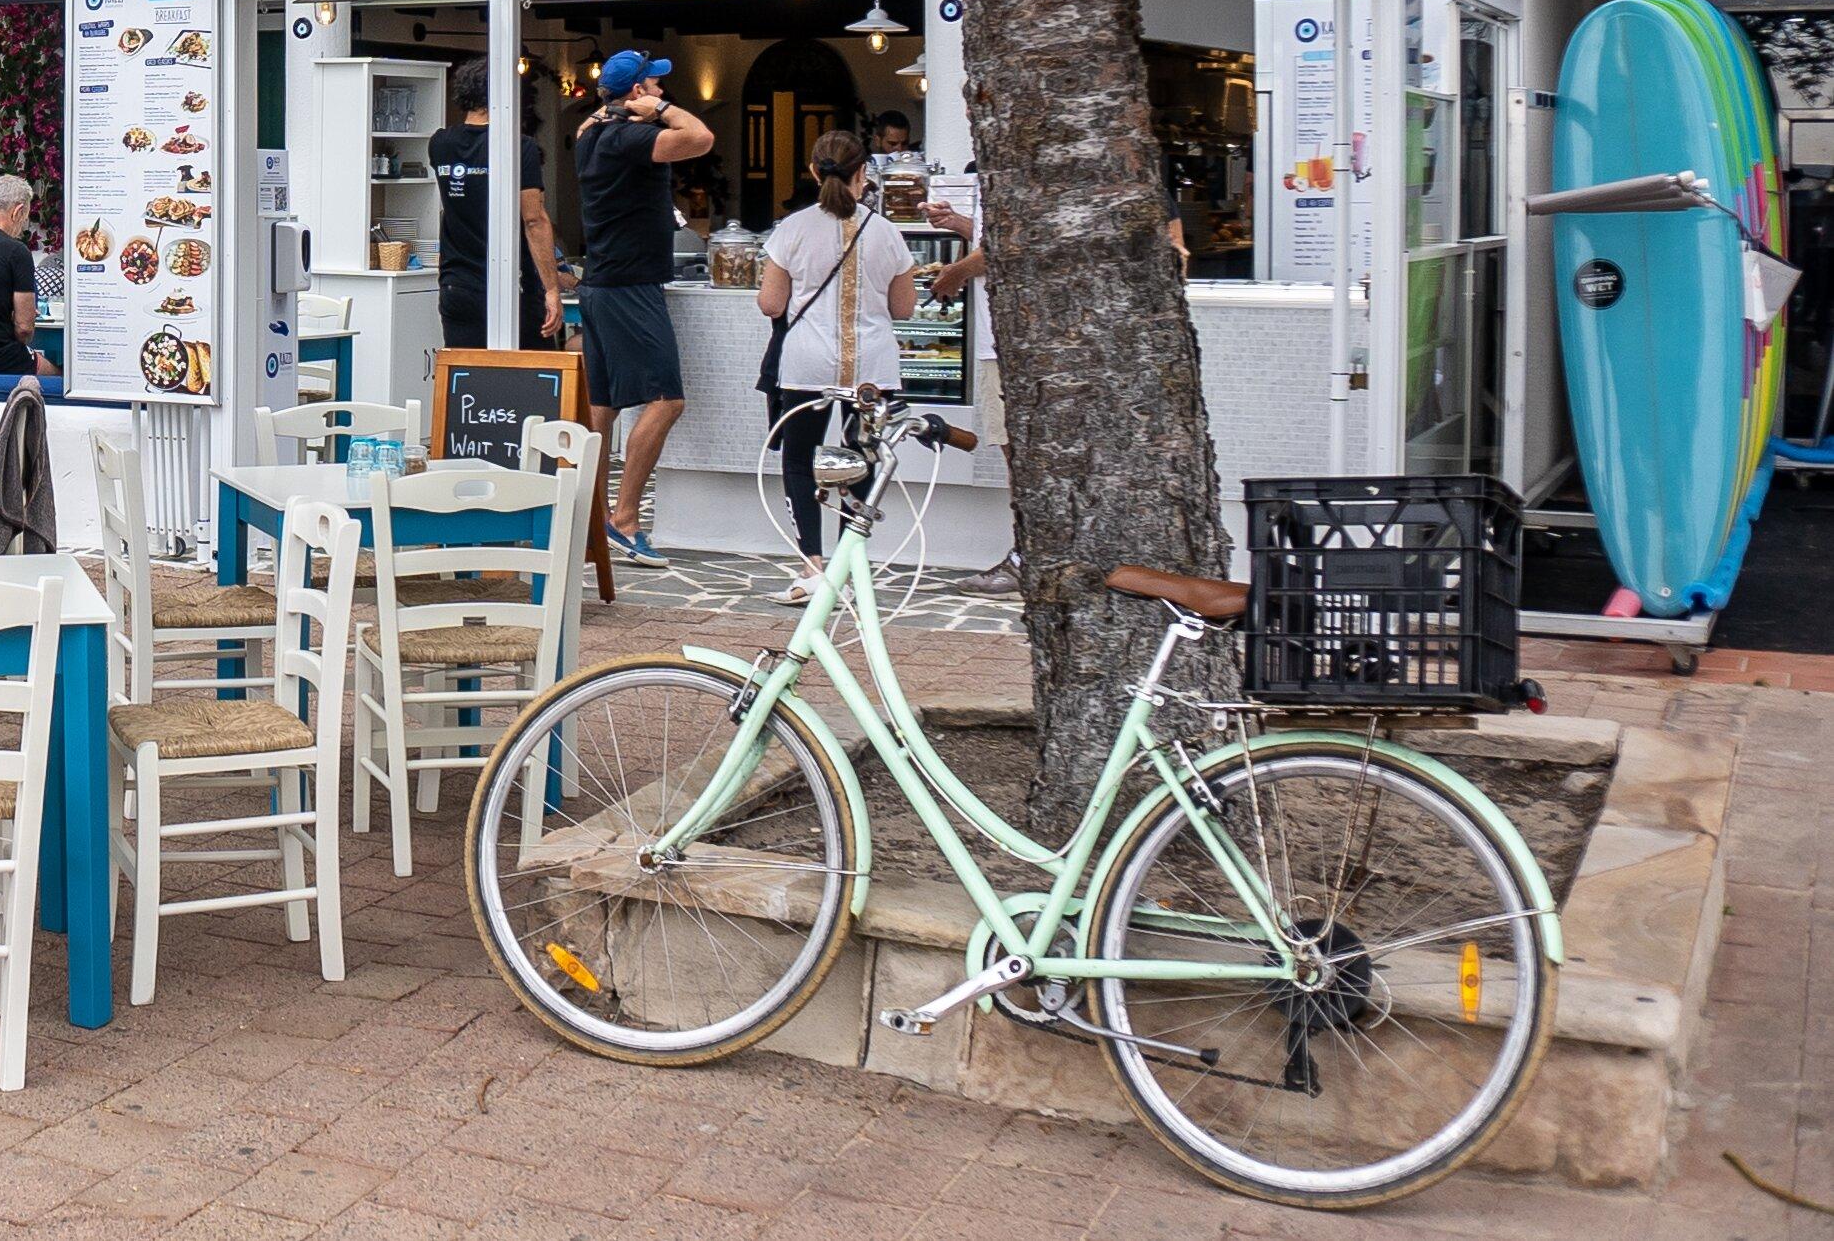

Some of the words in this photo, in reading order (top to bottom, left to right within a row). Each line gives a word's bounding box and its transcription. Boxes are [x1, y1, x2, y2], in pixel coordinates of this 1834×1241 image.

[155, 8, 192, 23] BREAKFAST
[1585, 282, 1614, 293] WET
[461, 393, 517, 424] PLEASE
[450, 431, 493, 457] WAIT
